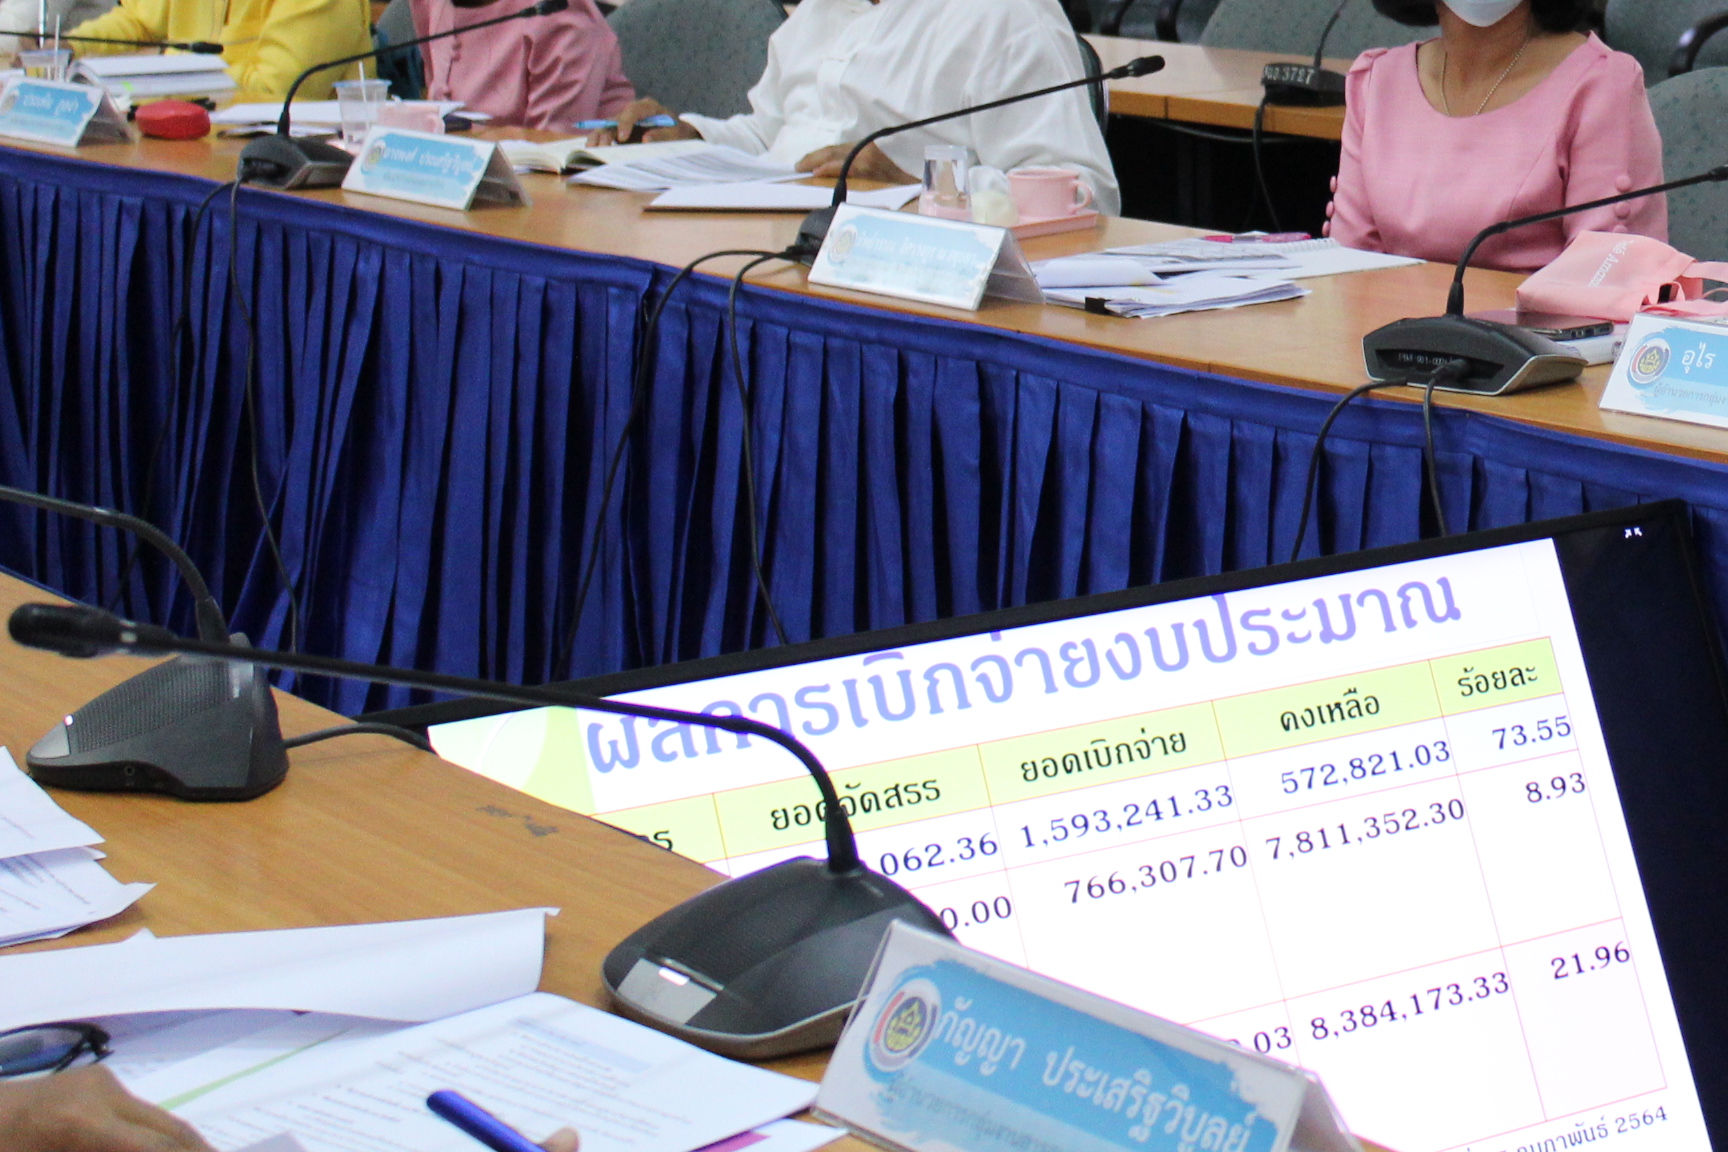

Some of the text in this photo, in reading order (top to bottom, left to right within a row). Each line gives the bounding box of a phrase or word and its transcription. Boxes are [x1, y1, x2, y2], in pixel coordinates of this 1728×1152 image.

[1680, 341, 1717, 375] อุไร
[1020, 728, 1187, 784] ยอดเบิกจ่าย
[1280, 687, 1381, 733] คงเหลือ
[1457, 664, 1538, 698] ร้อยละ
[879, 714, 1573, 878] 062.36 1,593,241.33 572,821.03 73.55
[1064, 843, 1249, 905] 766,307.70
[1265, 797, 1466, 862] 7,811,352.30
[1525, 771, 1587, 805] 8.93
[936, 996, 1027, 1077] กัญญา
[1309, 971, 1511, 1041] 8,384,173.33
[1549, 941, 1632, 981] 21.96
[1614, 1105, 1668, 1135] 2564
